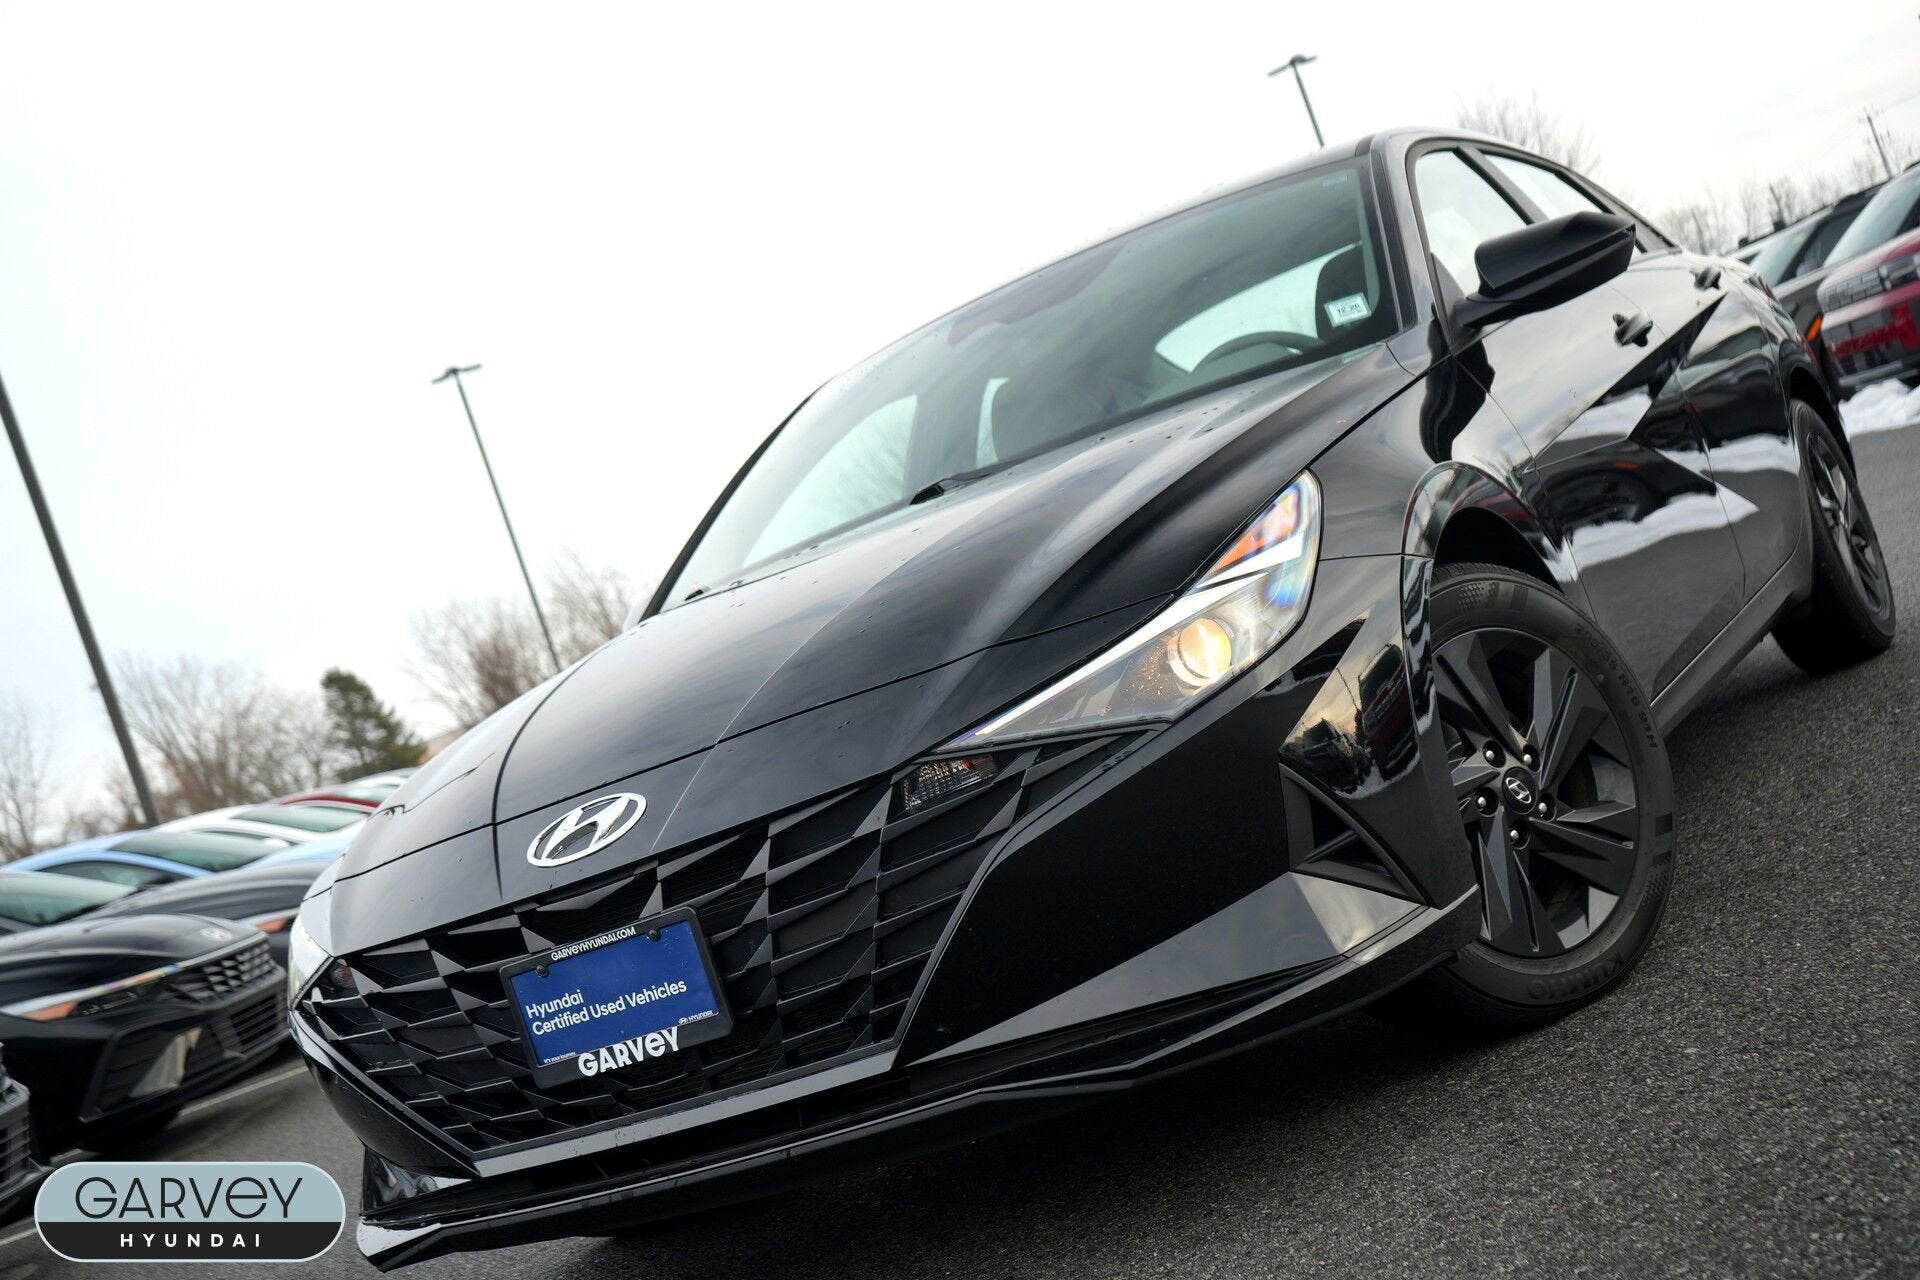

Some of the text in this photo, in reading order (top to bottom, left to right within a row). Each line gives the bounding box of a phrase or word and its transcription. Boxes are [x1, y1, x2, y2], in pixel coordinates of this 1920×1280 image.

[526, 989, 584, 1019] Hyundai
[532, 980, 687, 1036] Certified Used Vehicles
